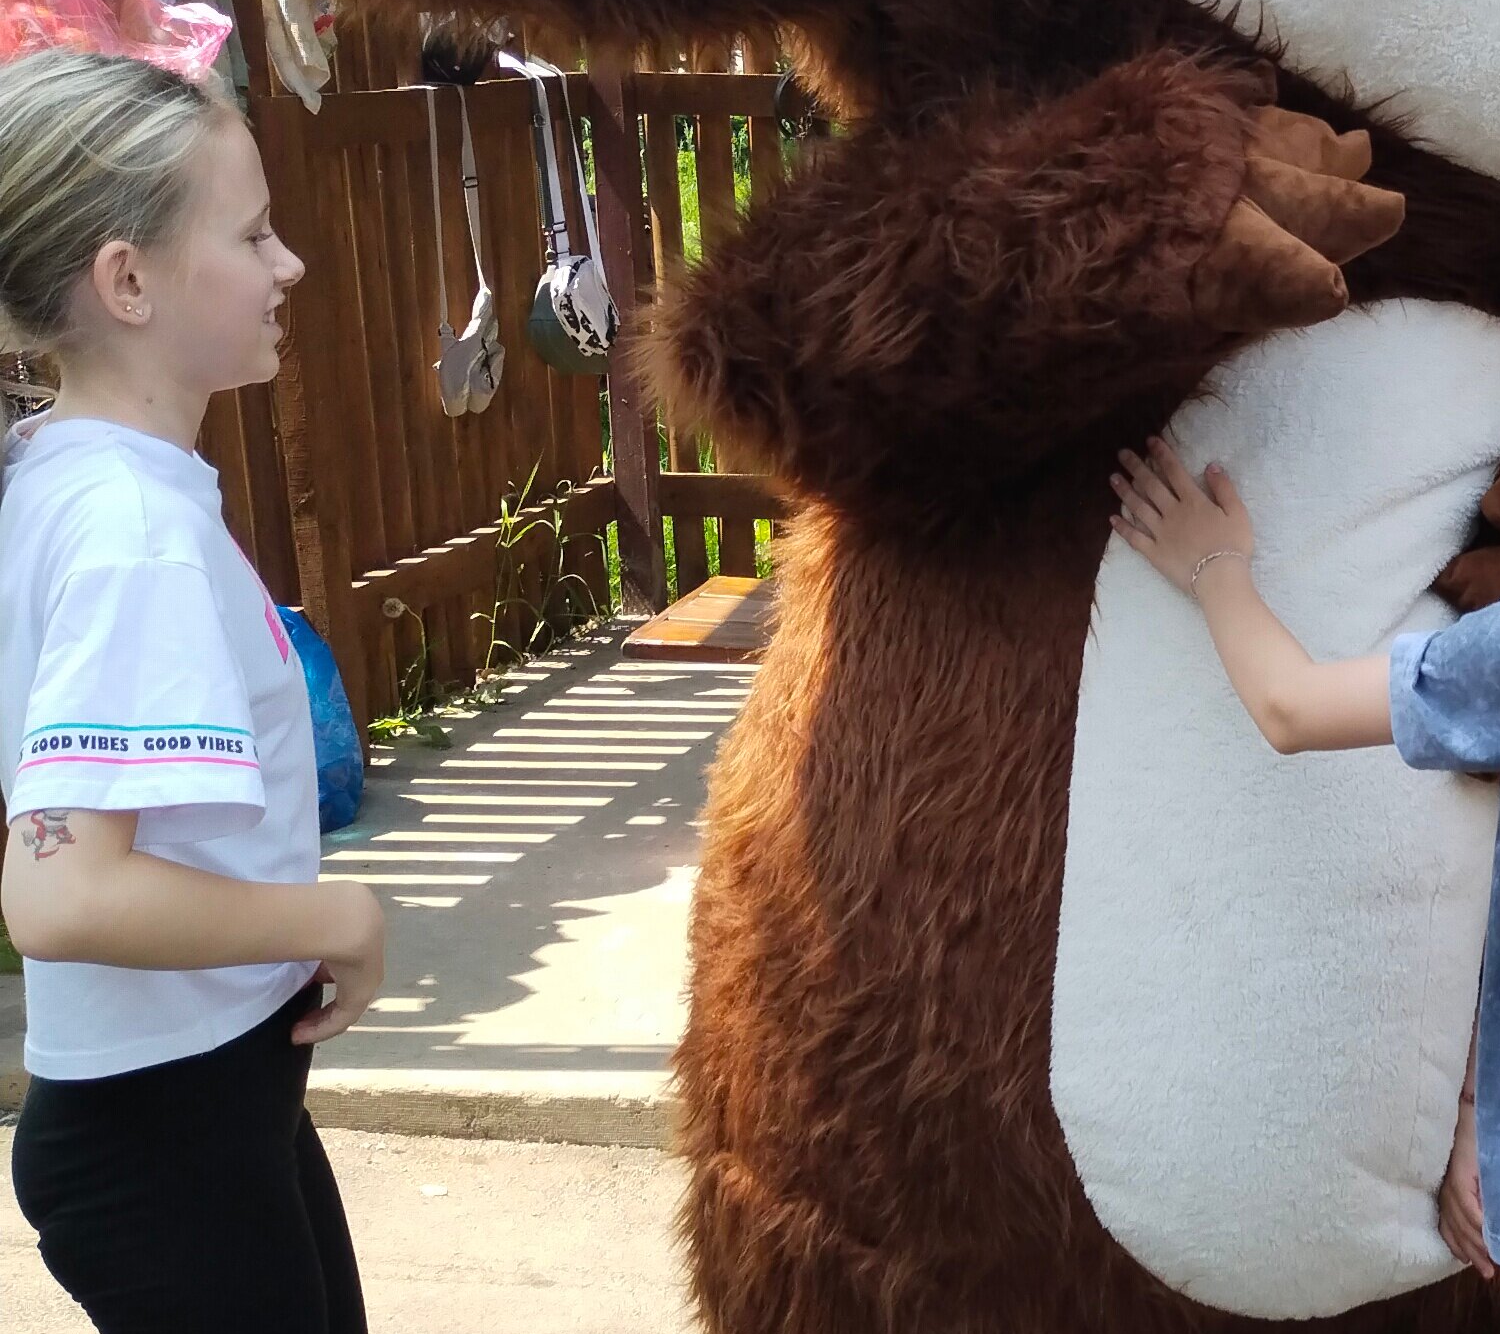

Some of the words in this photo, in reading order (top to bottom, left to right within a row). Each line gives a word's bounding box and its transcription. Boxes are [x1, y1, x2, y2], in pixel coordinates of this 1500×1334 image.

[31, 735, 73, 754] GOOD
[78, 734, 129, 752] VIBES
[143, 736, 191, 751] GOOD
[197, 735, 243, 754] VIBES
